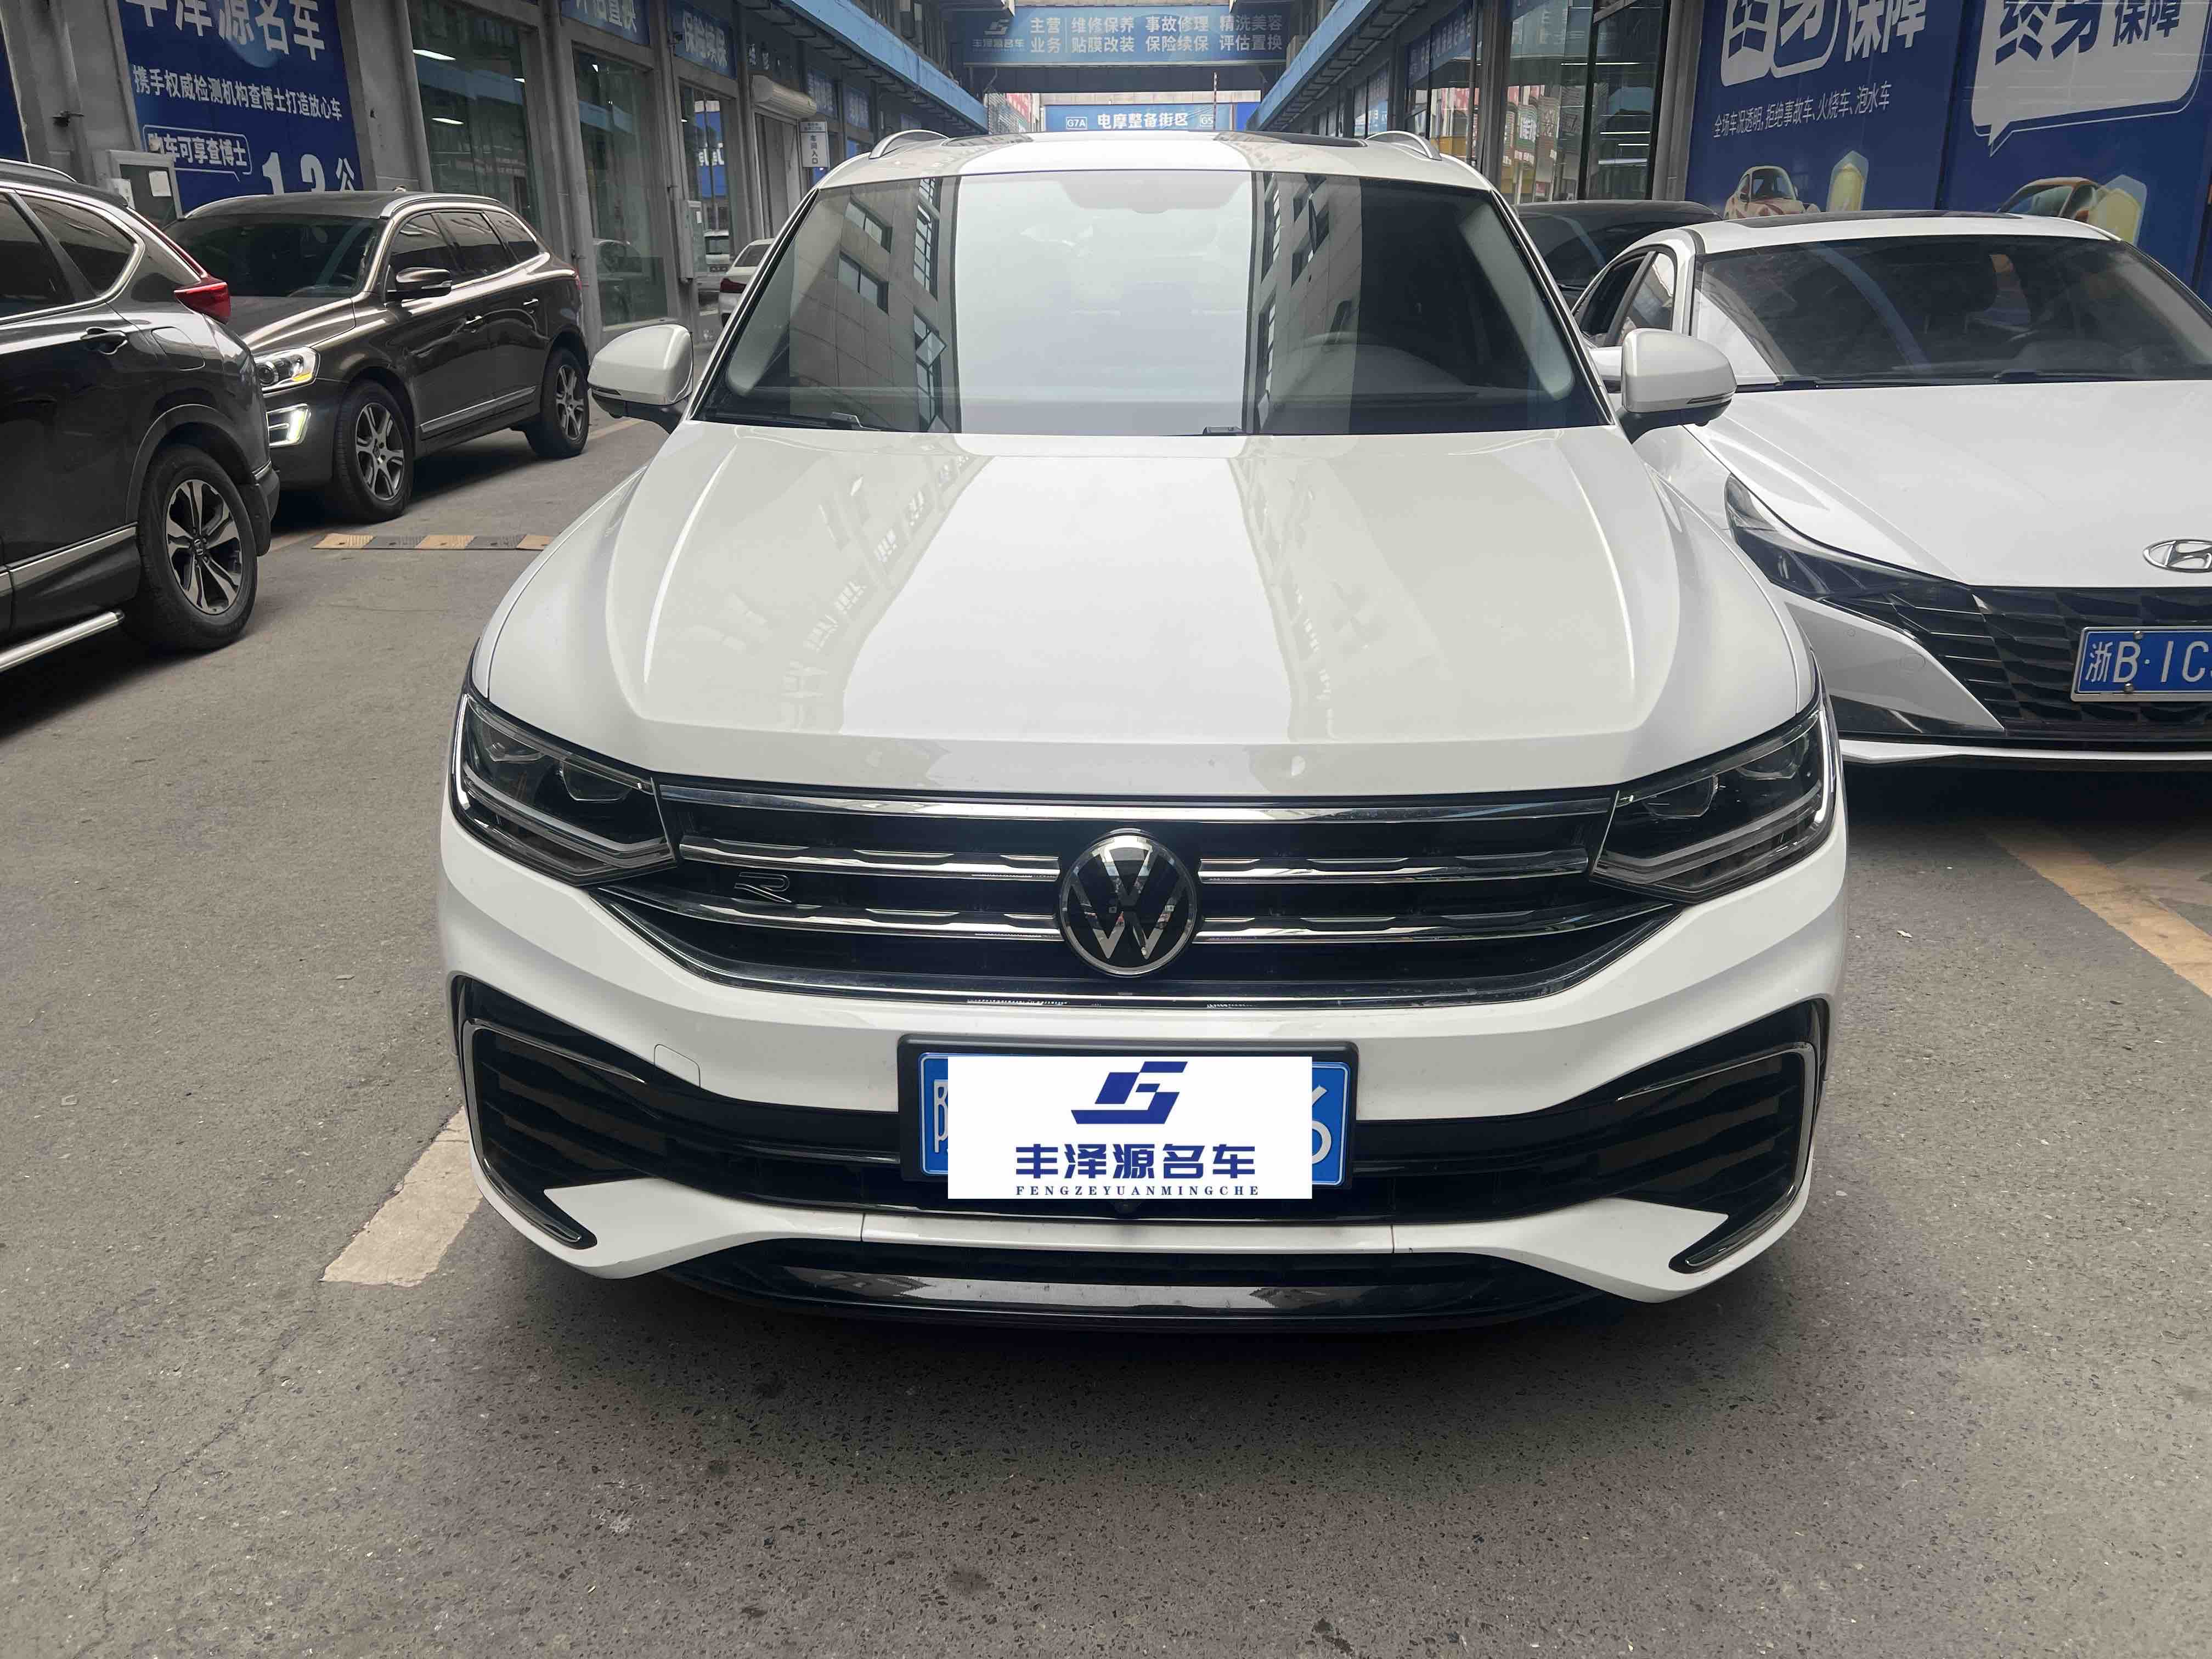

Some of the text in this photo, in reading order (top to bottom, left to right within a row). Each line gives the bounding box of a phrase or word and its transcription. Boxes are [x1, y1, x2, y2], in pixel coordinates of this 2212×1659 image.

[1030, 15, 1283, 34] 主营 维修保养 事故修理 精洗美容
[1030, 34, 1283, 53] 业务 贴膜改装 保险续保 评估置换
[133, 65, 342, 120] 携手权威检测机构查博士打造放心车
[1067, 119, 1086, 127] G7A
[1097, 113, 1189, 129] 电摩整备街区
[2085, 640, 2212, 683] 浙B·1C
